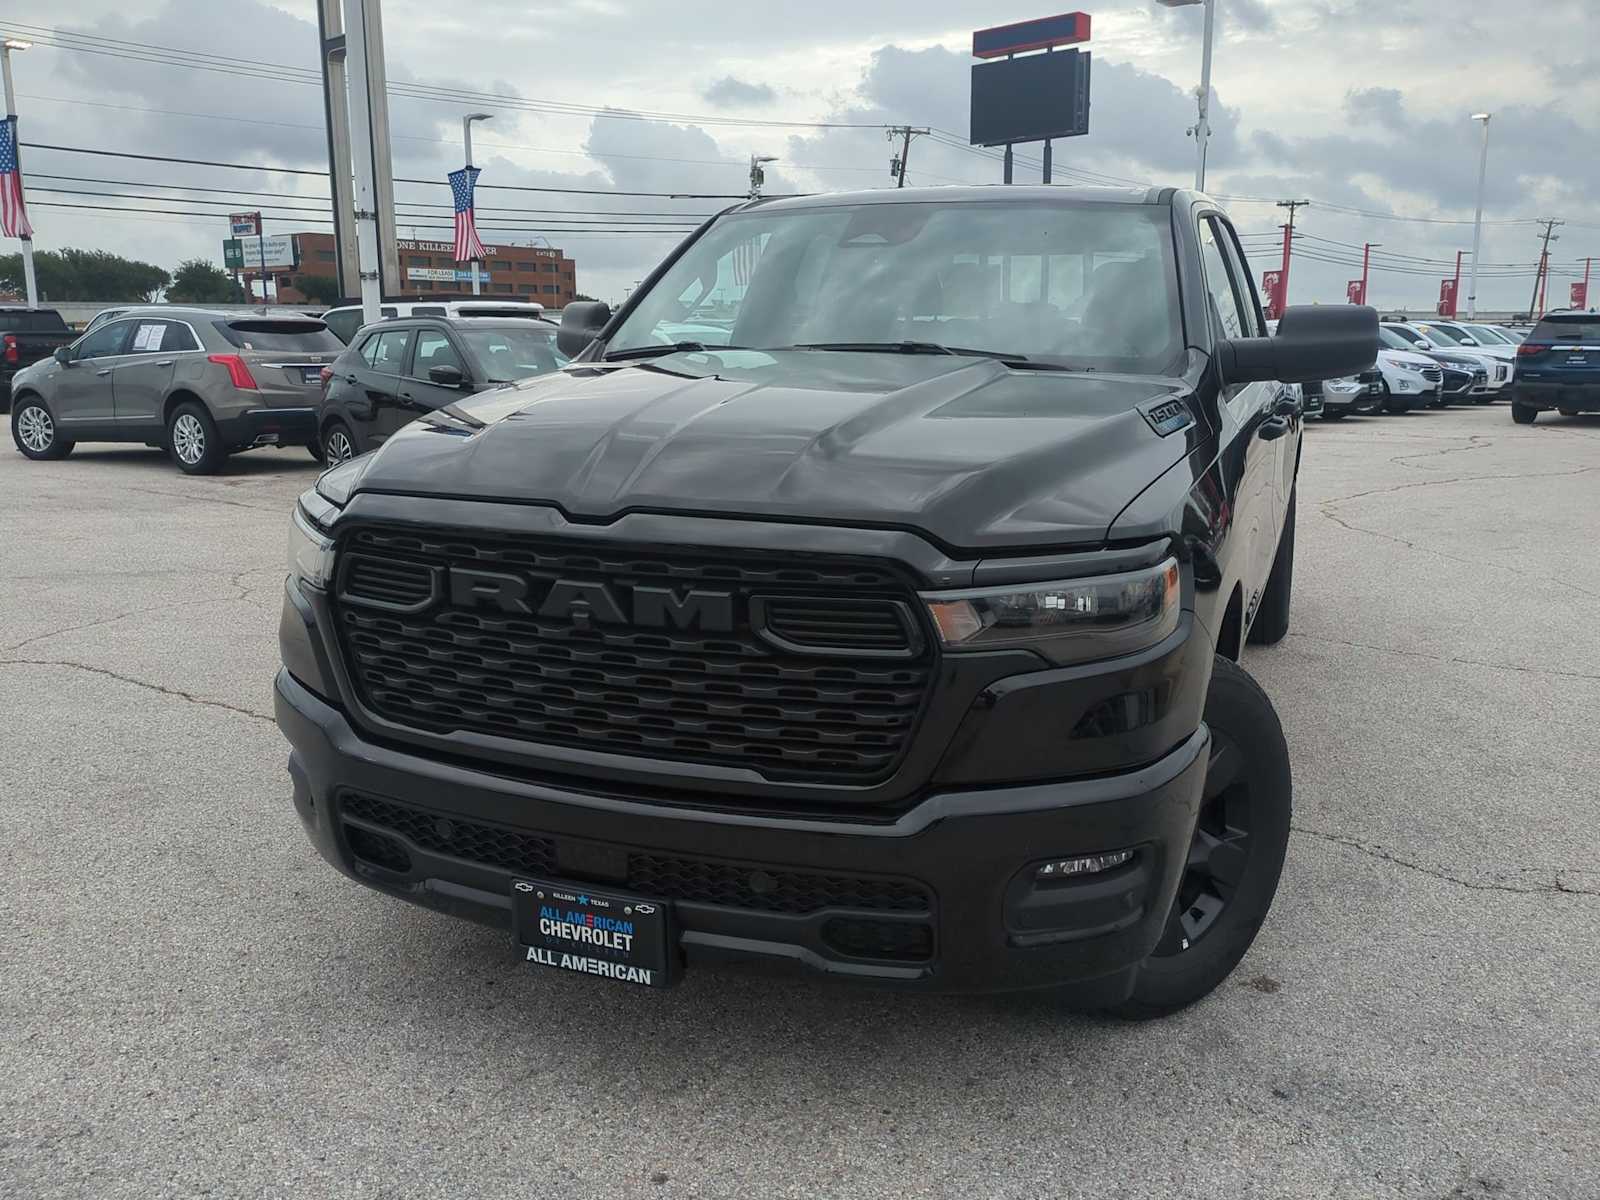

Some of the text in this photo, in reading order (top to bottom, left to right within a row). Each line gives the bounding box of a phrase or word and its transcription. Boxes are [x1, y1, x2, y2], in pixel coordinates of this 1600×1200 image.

[449, 566, 733, 633] RAM
[553, 892, 609, 908] KILLEEN TEXAS
[539, 918, 633, 952] CHEVROLET
[540, 905, 633, 934] ALL AMERICAN
[526, 946, 652, 985] ALL AMERICAN
